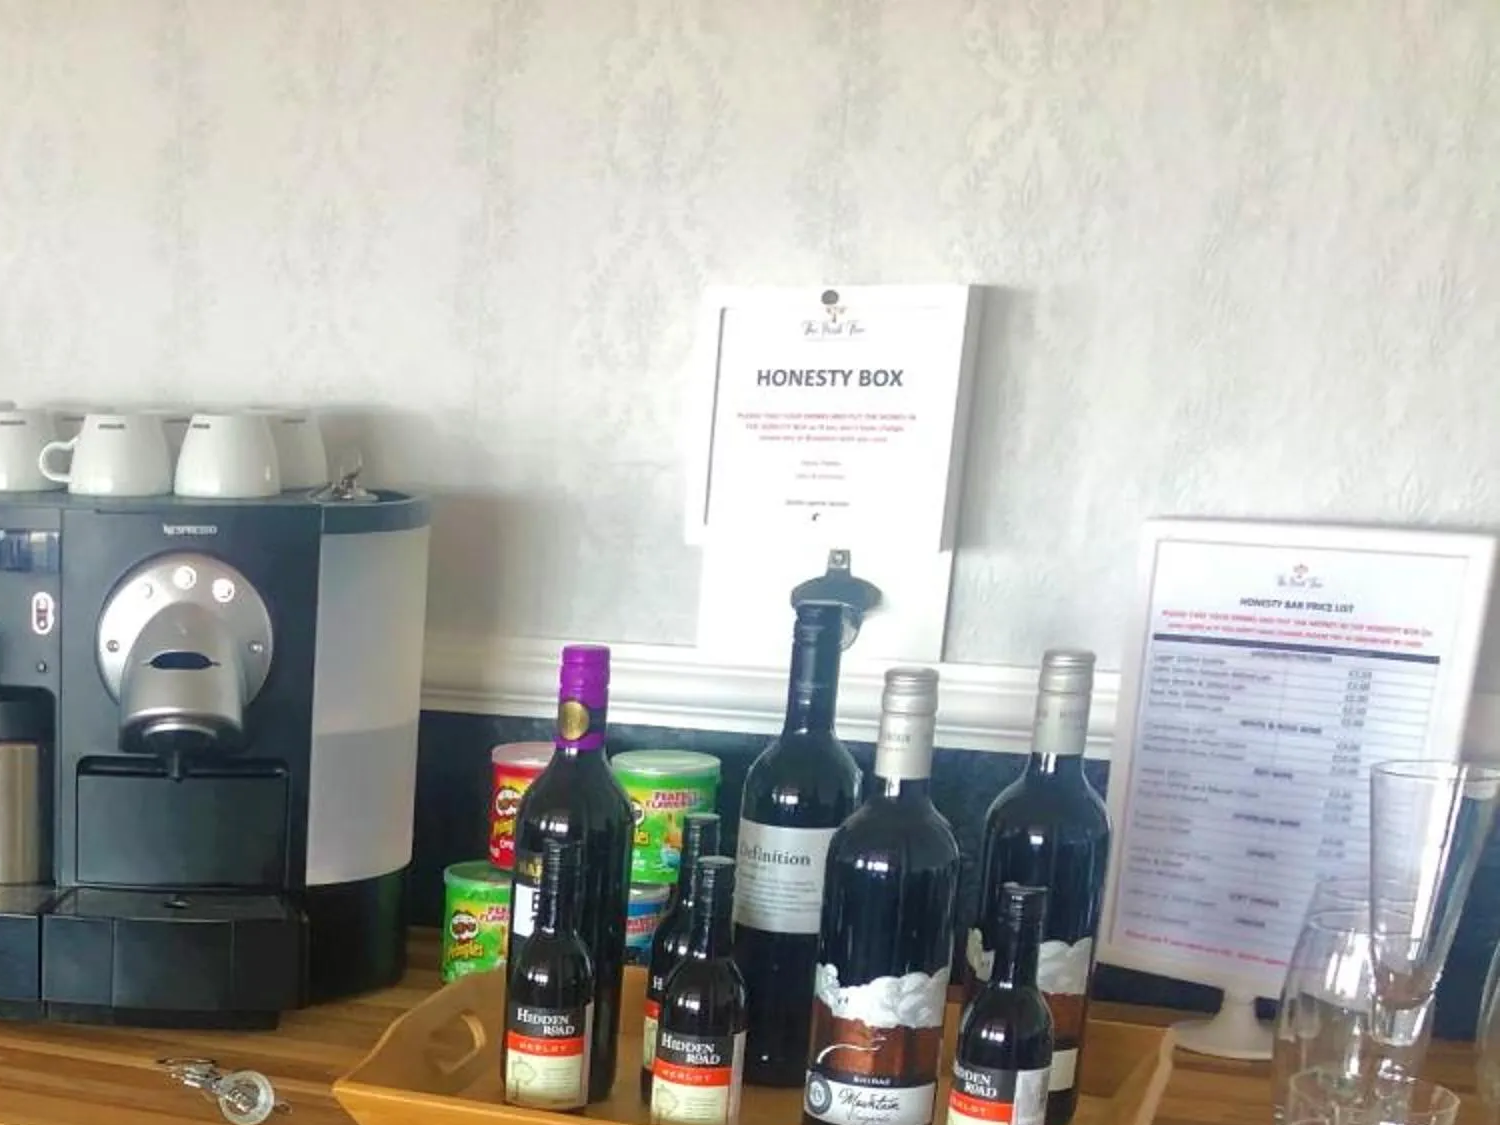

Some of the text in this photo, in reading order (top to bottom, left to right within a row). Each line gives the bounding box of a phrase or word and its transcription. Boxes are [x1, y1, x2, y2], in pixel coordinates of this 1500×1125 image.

[757, 369, 904, 387] HONESTY BOX
[517, 1007, 570, 1025] HIDDEN
[543, 1025, 575, 1037] ROAD
[661, 1032, 716, 1054] HIDDEN
[685, 1053, 721, 1066] ROAD
[964, 1082, 998, 1098] ROAD
